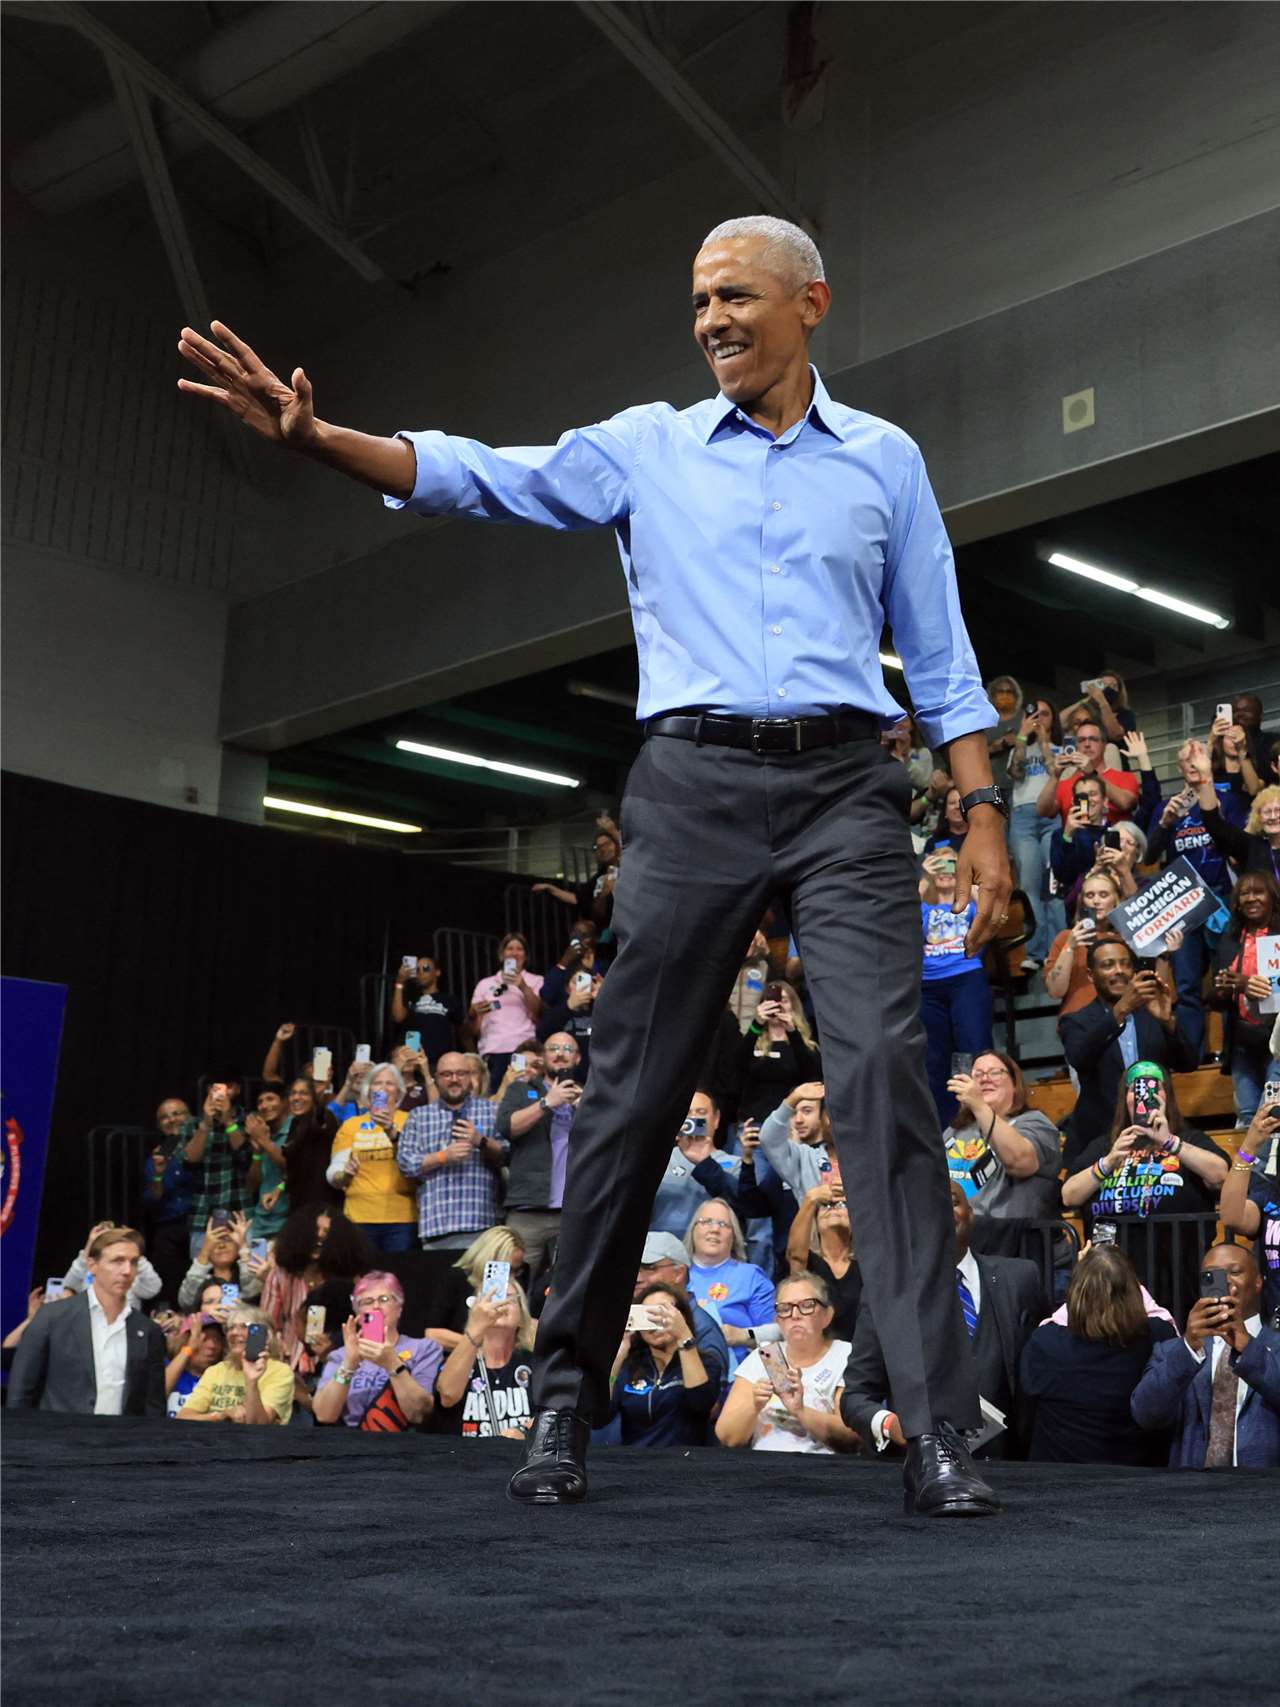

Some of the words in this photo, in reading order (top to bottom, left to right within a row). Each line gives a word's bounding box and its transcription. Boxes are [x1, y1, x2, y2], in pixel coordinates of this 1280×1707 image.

[1175, 833, 1212, 852] BENS
[1126, 876, 1193, 932] MICHIGAN
[1127, 871, 1178, 916] MOVING
[1135, 889, 1203, 943] FORWARD
